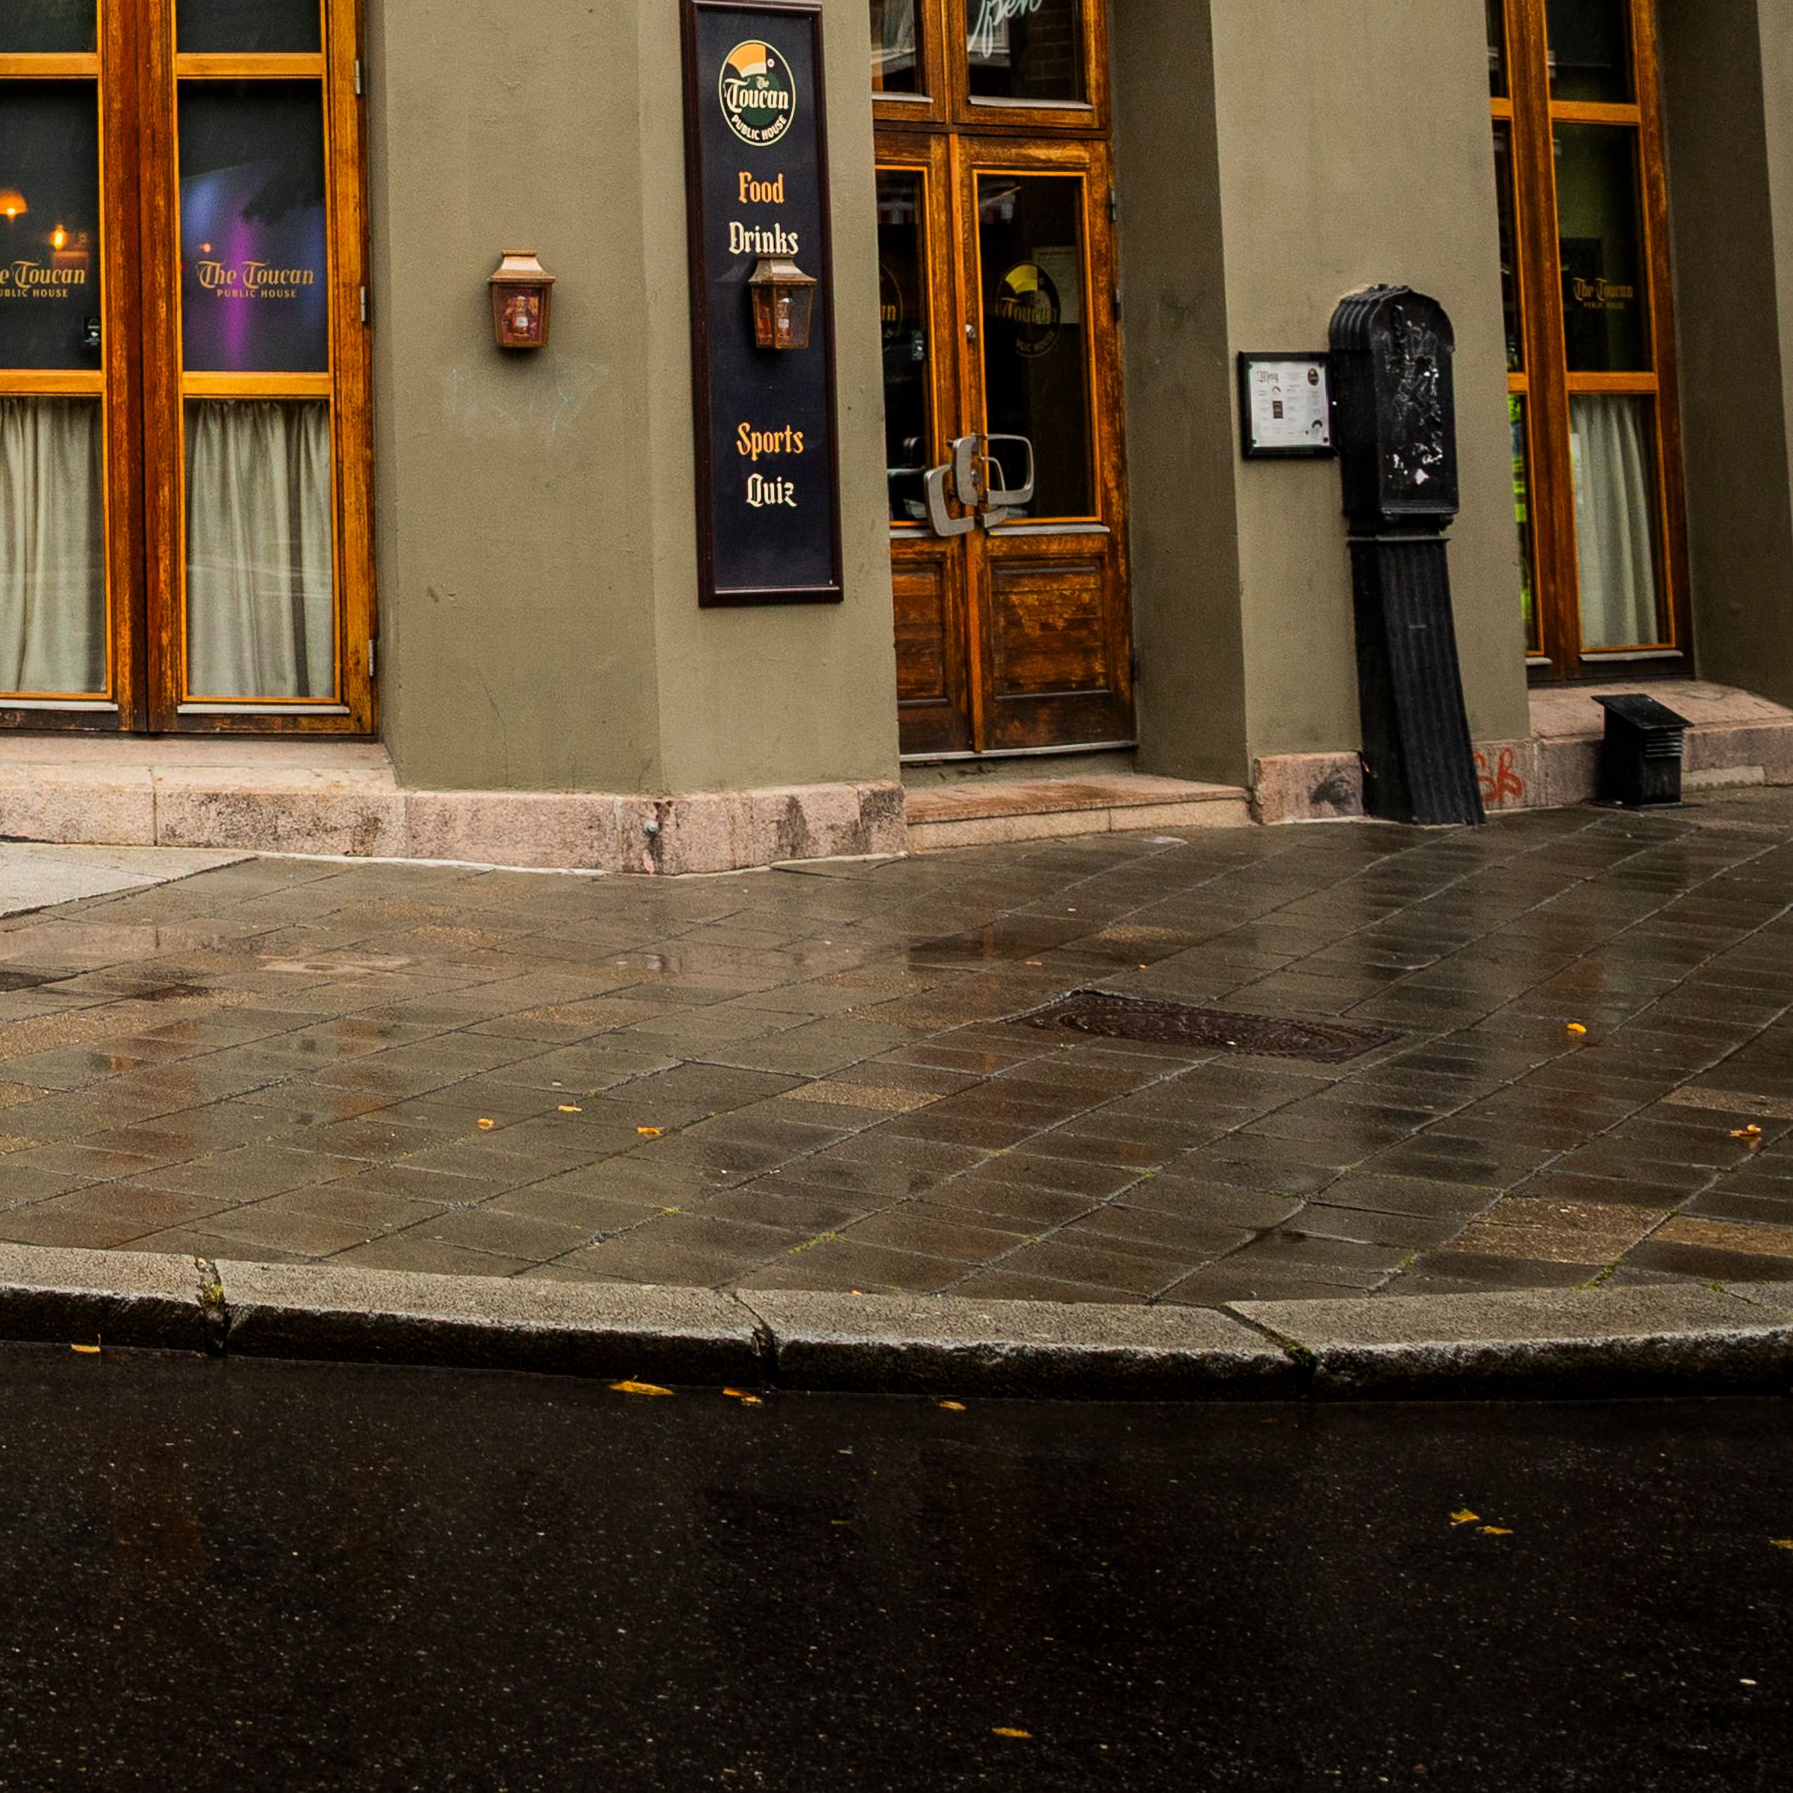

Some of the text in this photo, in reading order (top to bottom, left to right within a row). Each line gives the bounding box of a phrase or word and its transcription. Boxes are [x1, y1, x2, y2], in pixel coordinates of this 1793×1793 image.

[723, 76, 790, 113] Toucan
[755, 75, 771, 91] The
[730, 113, 789, 141] PUBLIC HOUSE
[738, 171, 785, 205] Food
[728, 222, 800, 255] Drinks
[10, 260, 86, 289] Toucan
[196, 260, 315, 289] The Toucan
[1573, 277, 1594, 301] The
[32, 289, 69, 298] HOUSE
[217, 288, 297, 298] PUBLIC HOUSE
[736, 422, 804, 462] Sports
[746, 474, 797, 507] Quiz
